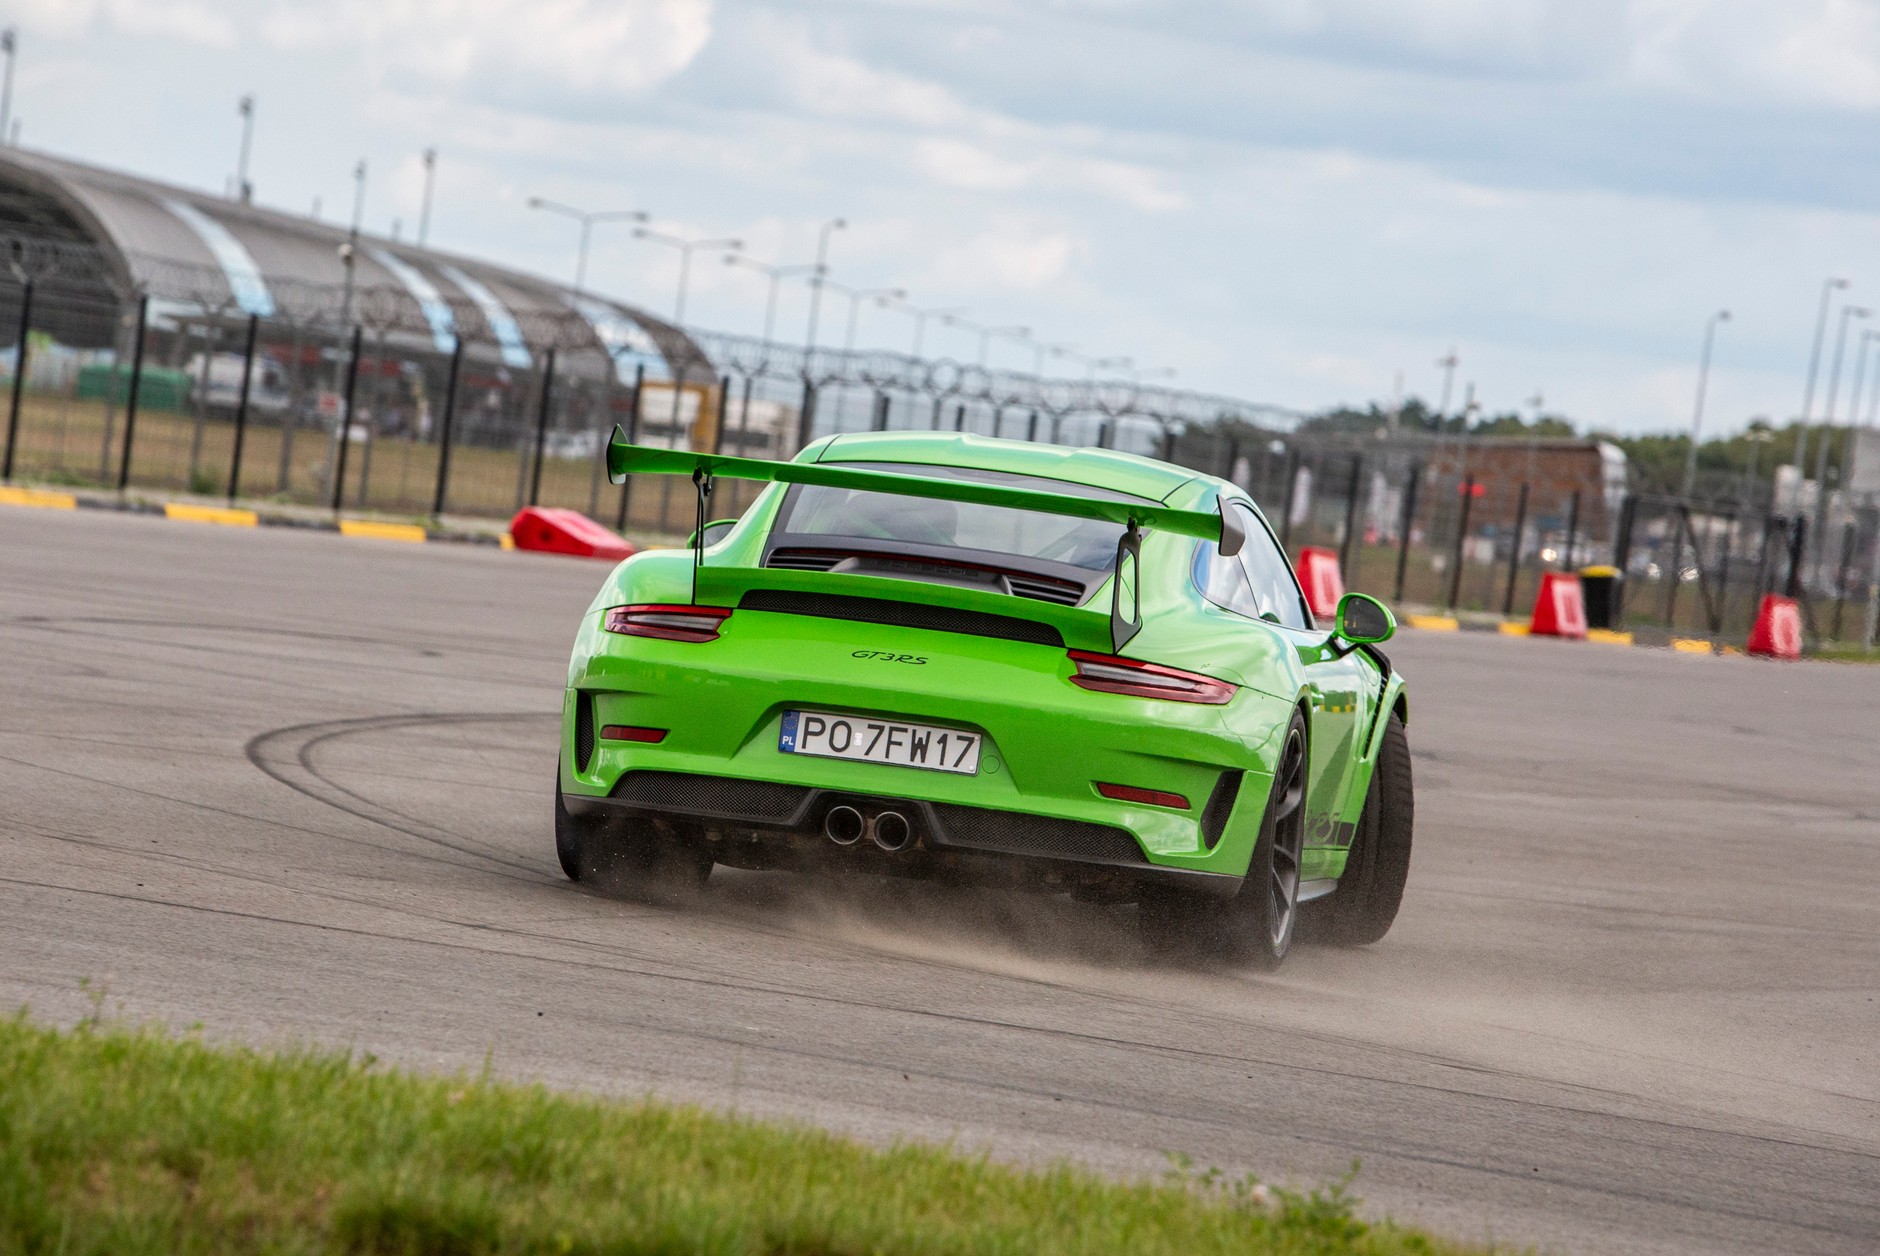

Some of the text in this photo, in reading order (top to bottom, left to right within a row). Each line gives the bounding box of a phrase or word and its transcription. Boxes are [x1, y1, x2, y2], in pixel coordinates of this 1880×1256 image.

[782, 735, 794, 746] PL
[801, 716, 976, 768] PO 7FW17
